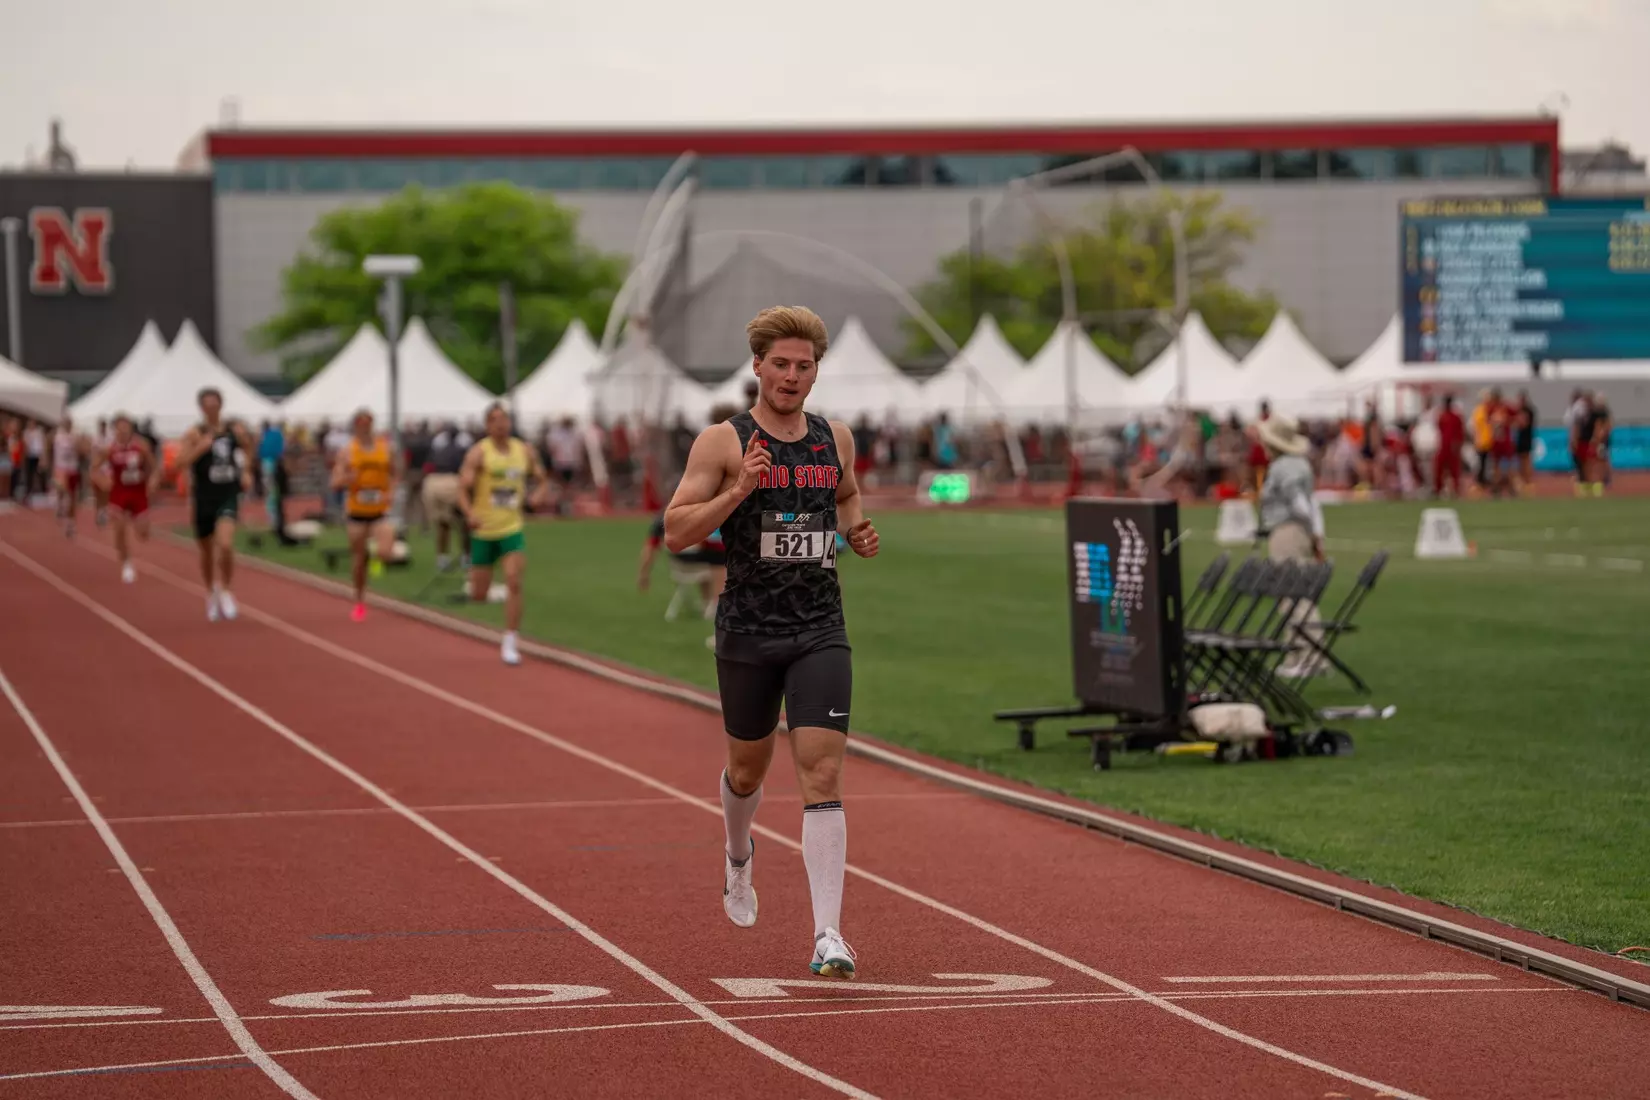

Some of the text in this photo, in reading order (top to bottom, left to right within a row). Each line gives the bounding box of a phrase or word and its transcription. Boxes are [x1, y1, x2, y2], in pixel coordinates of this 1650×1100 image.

[29, 207, 112, 294] N
[759, 465, 838, 488] HIO STATE
[775, 534, 812, 557] 521
[269, 983, 611, 1008] 3
[711, 973, 1054, 997] 2
